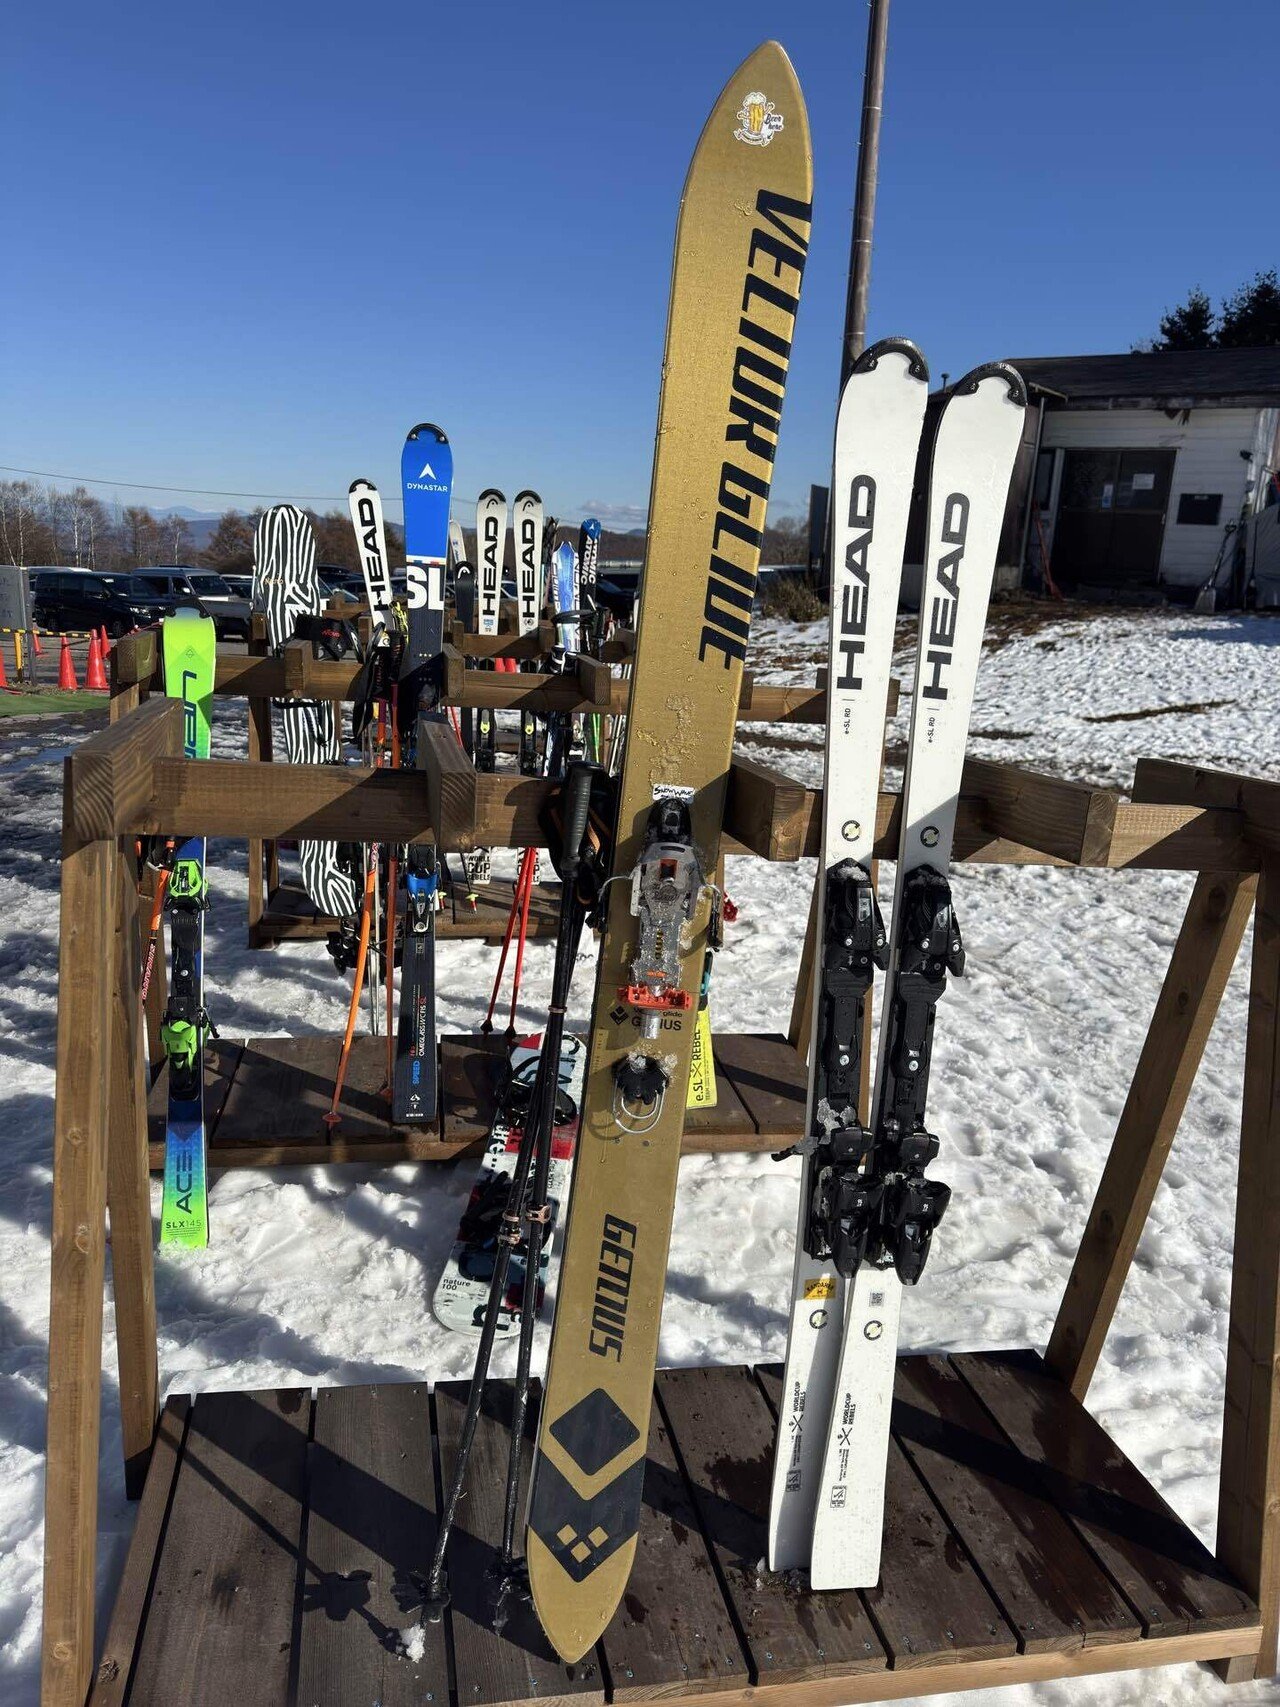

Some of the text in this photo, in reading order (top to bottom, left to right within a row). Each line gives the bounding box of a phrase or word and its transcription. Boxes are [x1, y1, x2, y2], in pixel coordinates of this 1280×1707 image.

[406, 482, 448, 492] DYNASTAR
[358, 498, 389, 612] HEAD
[482, 516, 498, 616] HEAD
[522, 518, 535, 618] HEAD
[580, 534, 593, 586] ATOMIC
[698, 461, 772, 670] GLIDE
[406, 565, 444, 611] SL
[837, 474, 877, 690] HEAD
[922, 492, 970, 700] HEAD
[845, 707, 851, 719] RD
[929, 716, 936, 728] RD
[468, 863, 490, 873] CUP
[631, 1016, 682, 1031] GIUS
[412, 1060, 420, 1085] SPEED
[175, 1149, 192, 1214] ACE
[442, 1283, 458, 1291] 100
[443, 1278, 471, 1287] nature
[589, 1213, 637, 1363] GENIUS
